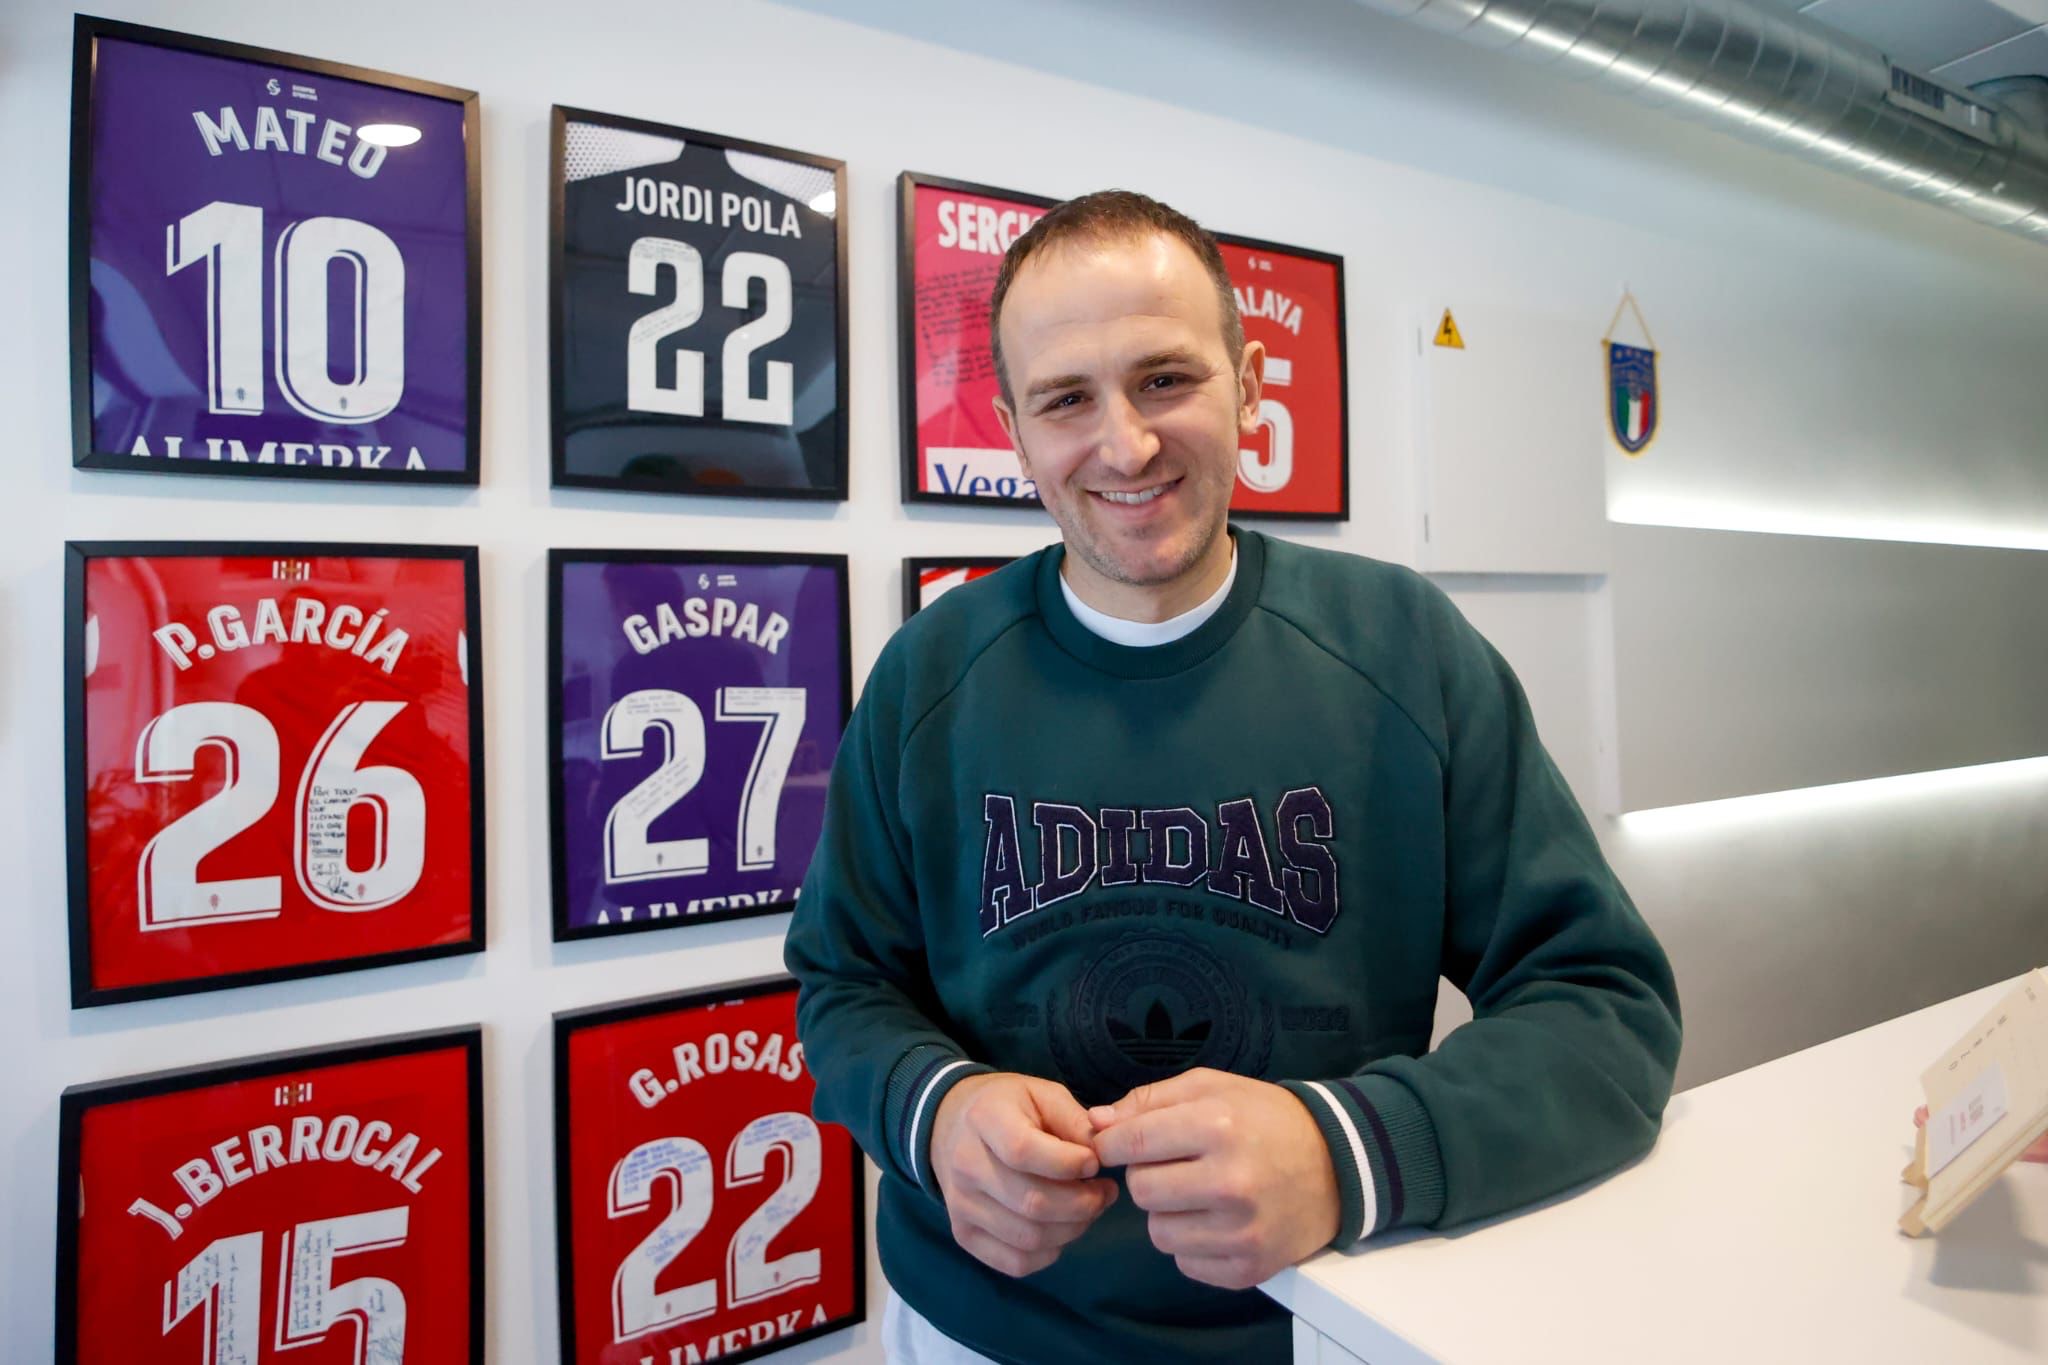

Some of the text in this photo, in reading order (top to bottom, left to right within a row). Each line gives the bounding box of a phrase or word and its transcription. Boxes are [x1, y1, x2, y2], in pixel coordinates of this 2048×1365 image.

[193, 106, 387, 179] MATEO
[616, 176, 801, 238] JORDI POLA
[167, 201, 405, 424] 10
[627, 236, 793, 426] 22
[153, 598, 409, 674] P.GARCÍA
[623, 597, 789, 655] GASPAR
[135, 701, 426, 932] 26
[601, 687, 806, 885] 27
[980, 786, 1339, 939] ADIDAS
[629, 1030, 804, 1108] G.ROSAS
[127, 1115, 443, 1240] J.BERROCAL
[607, 1111, 822, 1344] 22
[163, 1205, 409, 1365] 15
